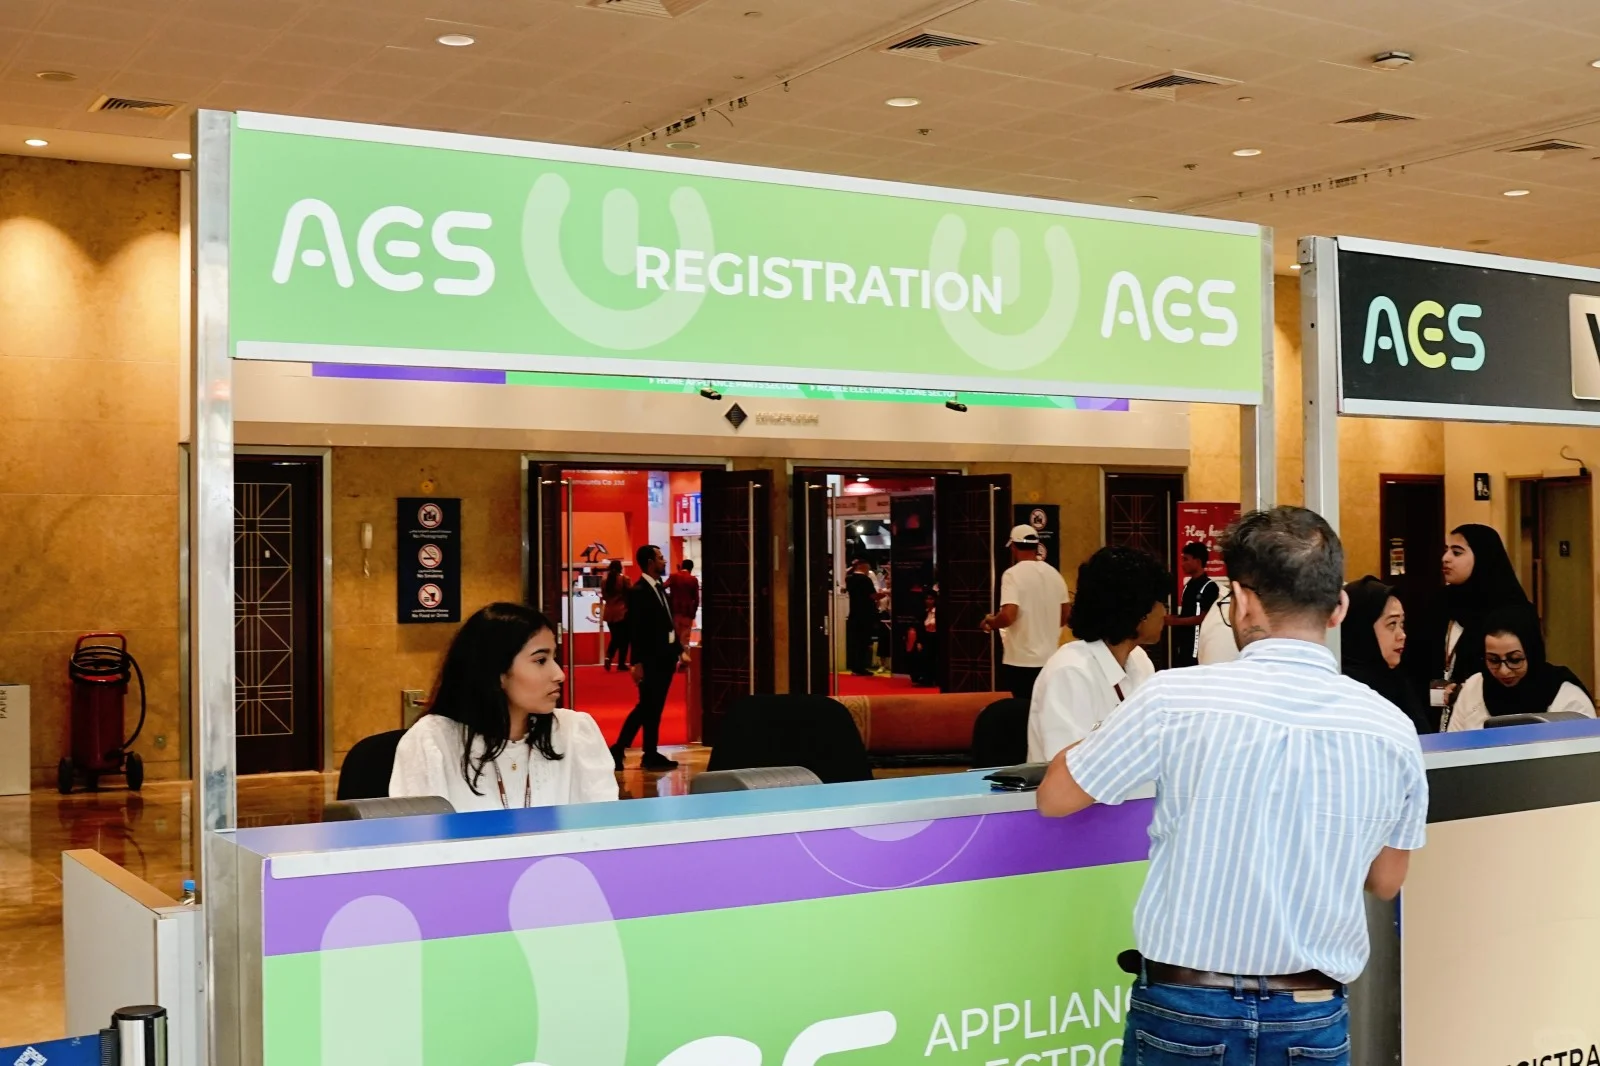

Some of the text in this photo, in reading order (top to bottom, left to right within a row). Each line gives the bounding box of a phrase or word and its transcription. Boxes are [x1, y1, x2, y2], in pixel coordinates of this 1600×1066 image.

[271, 197, 496, 297] AES
[634, 245, 1005, 315] REGISTRATION
[1101, 270, 1239, 348] AES
[1362, 295, 1486, 371] AES
[849, 386, 905, 396] ELECTRONICS
[924, 985, 1132, 1056] APPLIAN
